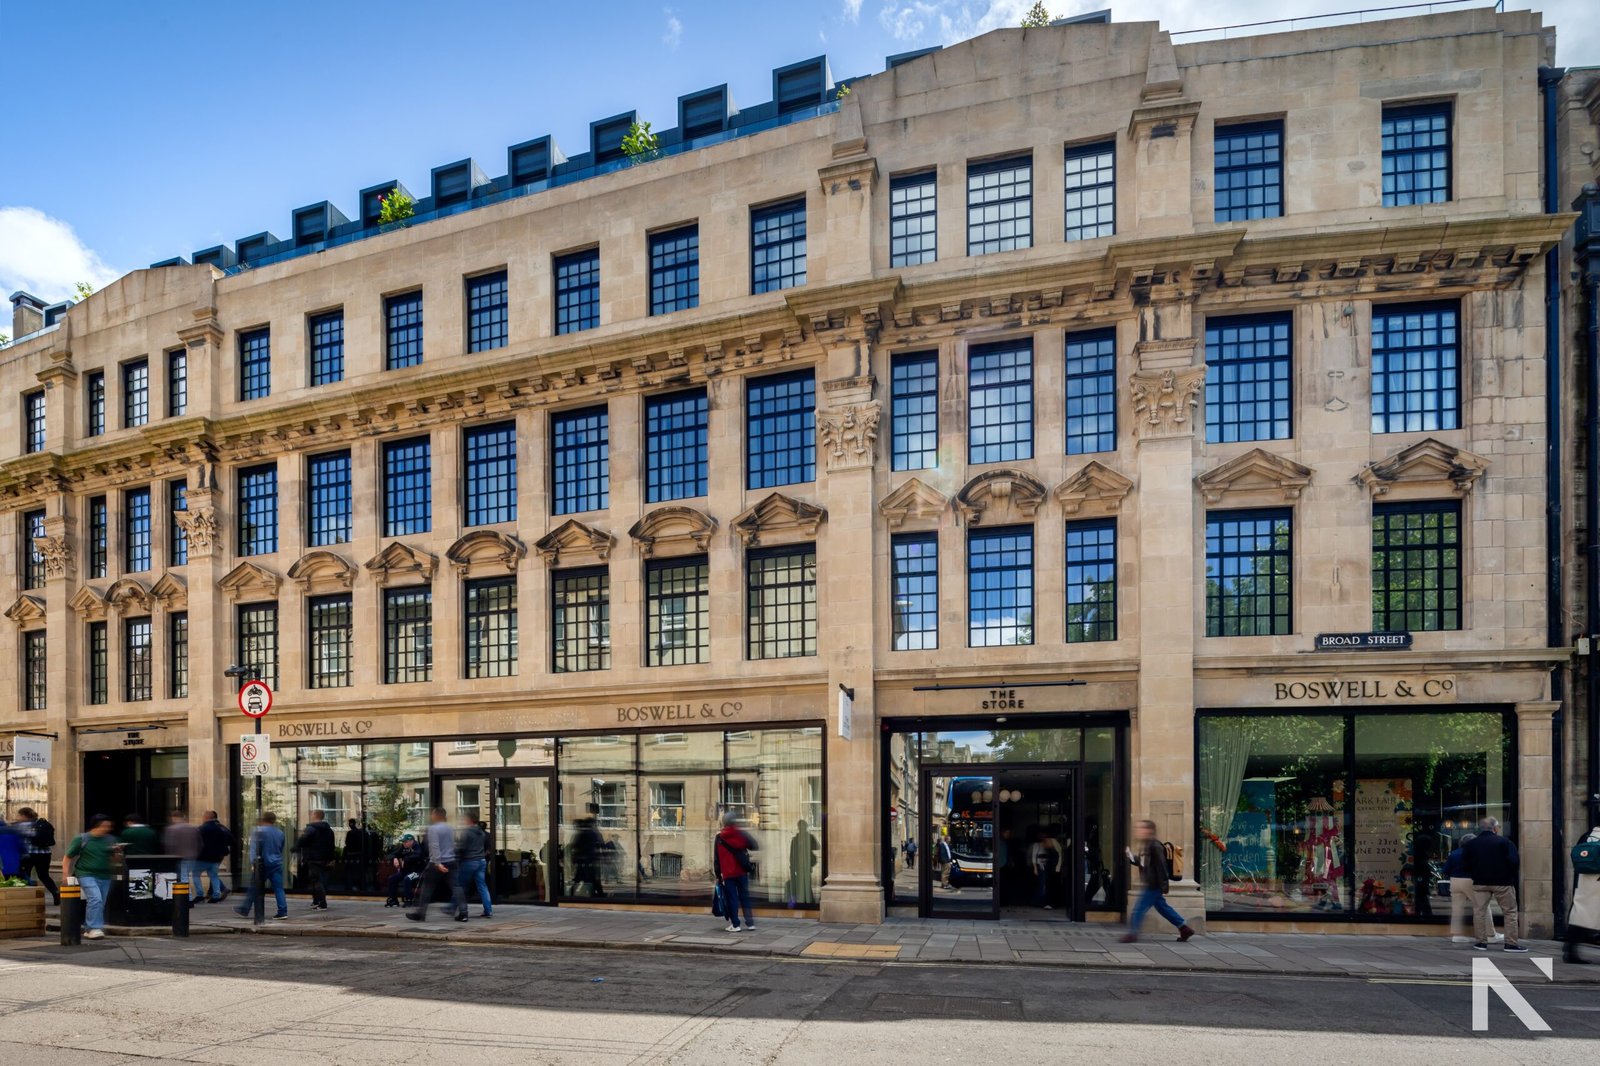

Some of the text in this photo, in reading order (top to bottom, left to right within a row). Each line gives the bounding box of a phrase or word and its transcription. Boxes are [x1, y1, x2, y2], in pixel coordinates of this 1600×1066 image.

[1322, 635, 1405, 645] BROAD STREET
[990, 689, 1015, 699] THE
[1275, 680, 1387, 700] BOSWELL
[1394, 680, 1416, 698] &
[982, 699, 1024, 709] STORE
[616, 704, 695, 722] BOSWELL
[700, 703, 715, 718] &
[278, 722, 337, 736] BOSWELL
[340, 721, 352, 734] &
[1356, 797, 1374, 805] ARK
[1355, 847, 1397, 855] UNE 2024
